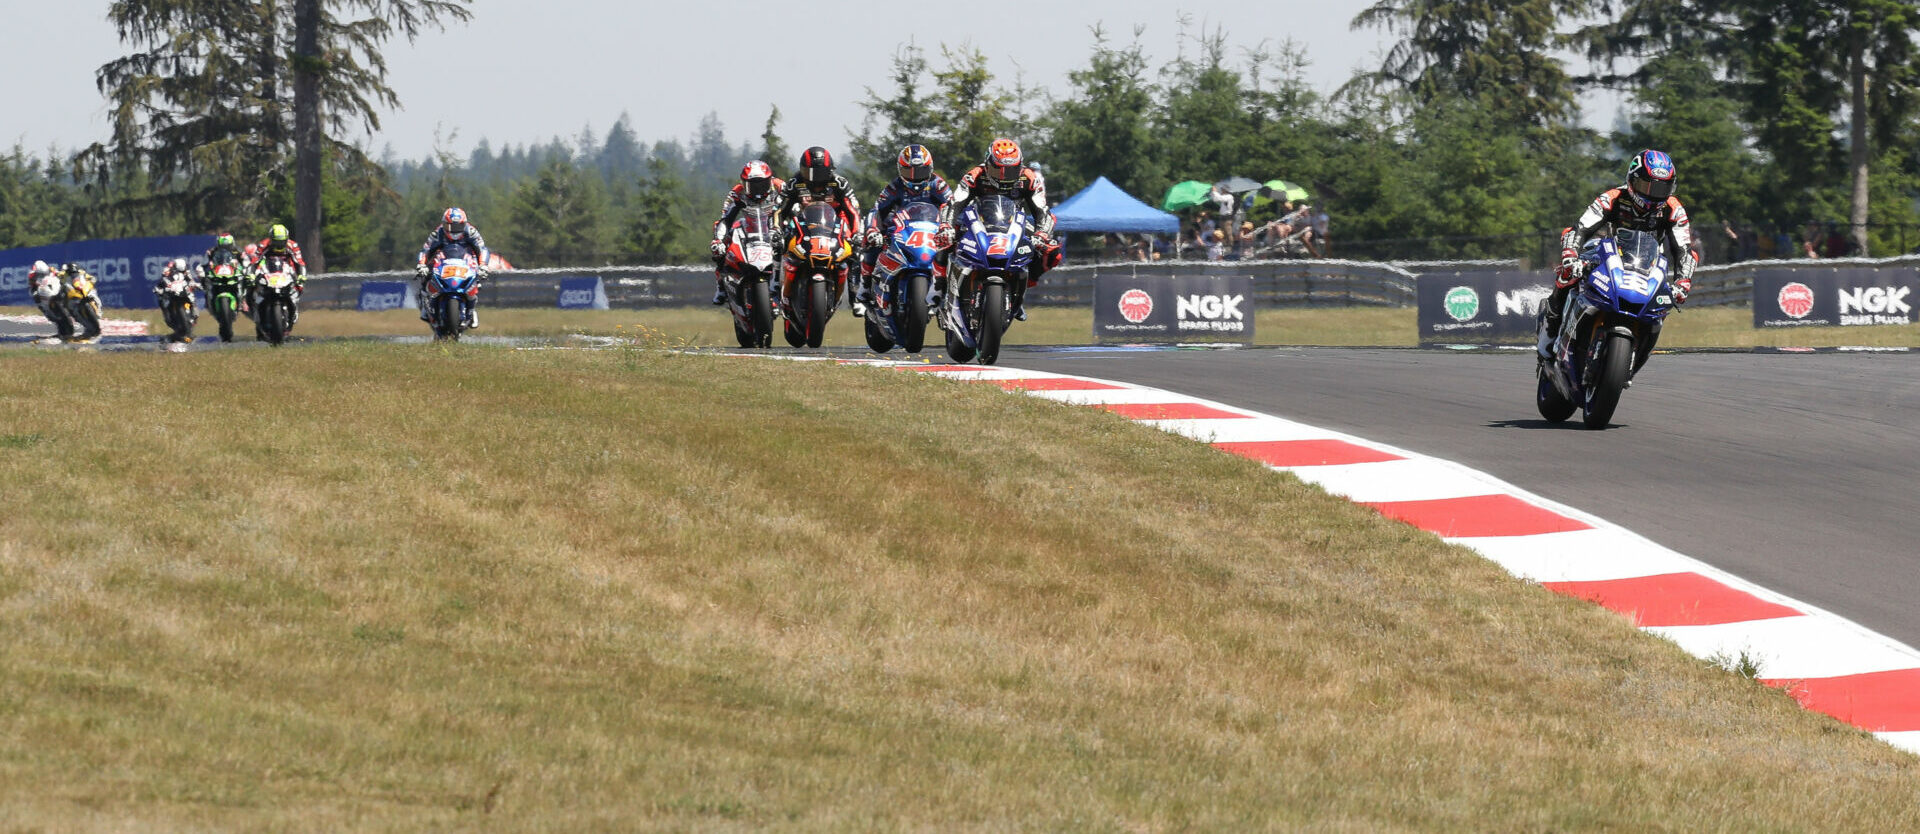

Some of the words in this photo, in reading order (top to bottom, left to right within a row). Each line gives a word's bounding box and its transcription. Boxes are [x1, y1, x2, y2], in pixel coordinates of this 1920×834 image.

[987, 237, 1008, 255] 2
[1618, 270, 1649, 296] 32
[1177, 294, 1244, 320] NGK
[1838, 286, 1912, 314] NGK
[1178, 320, 1210, 330] SPARK
[1212, 321, 1244, 331] PLUGS
